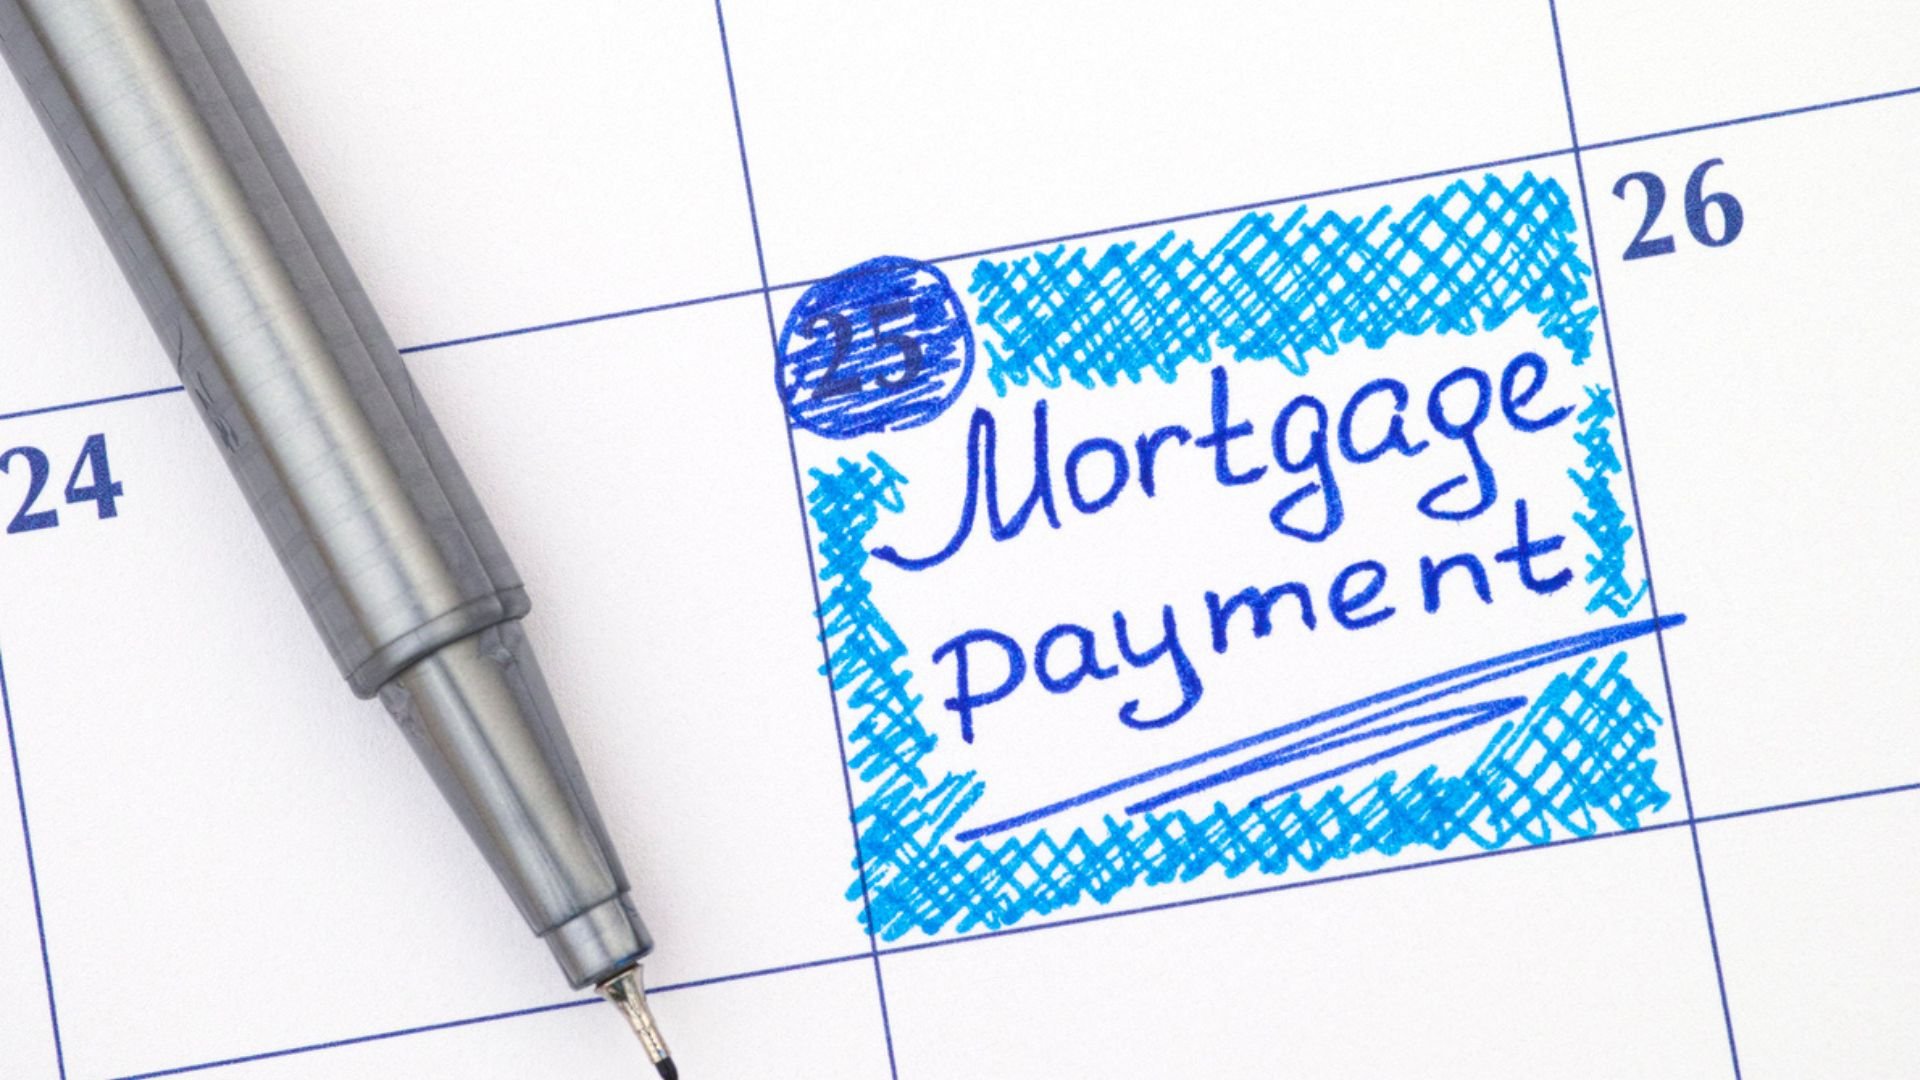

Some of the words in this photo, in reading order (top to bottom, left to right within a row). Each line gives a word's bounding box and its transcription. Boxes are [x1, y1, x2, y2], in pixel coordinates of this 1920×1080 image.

[1612, 158, 1743, 260] 26
[801, 298, 923, 401] 25
[0, 432, 124, 535] 24
[871, 352, 1575, 571] Mortgage
[932, 499, 1574, 744] payment
